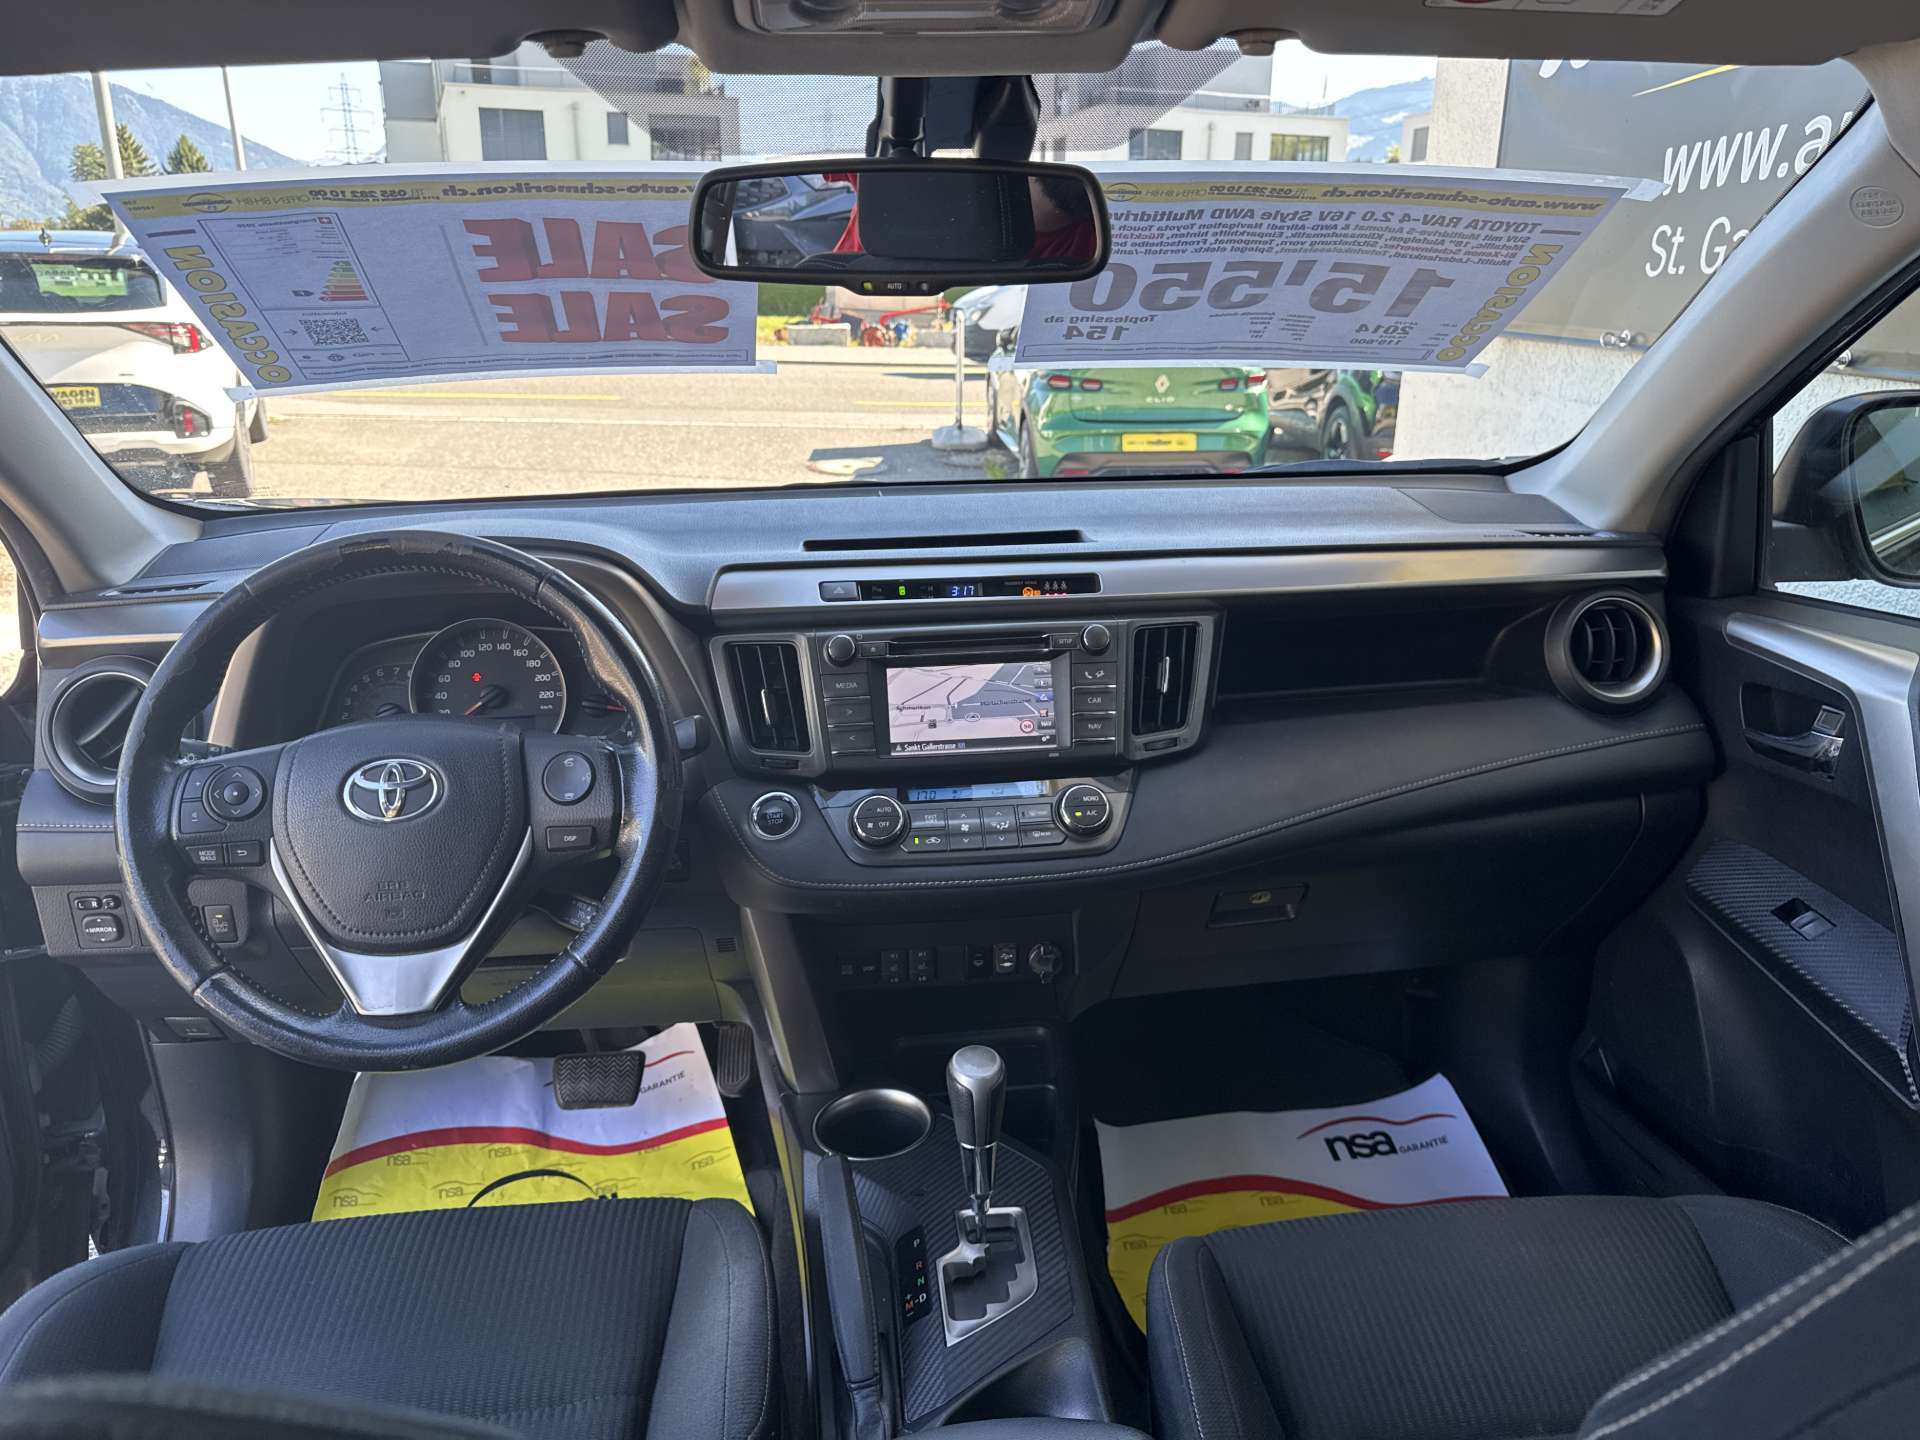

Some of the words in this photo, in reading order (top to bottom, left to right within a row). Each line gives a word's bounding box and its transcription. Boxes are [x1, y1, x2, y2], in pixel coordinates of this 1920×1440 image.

[1661, 111, 1853, 196] www.a
[1645, 225, 1686, 278] St.
[1700, 216, 1749, 275] G
[887, 282, 902, 290] AUTO
[478, 643, 492, 651] 120
[497, 642, 511, 650] 140
[460, 650, 475, 658] 100
[513, 649, 528, 657] 160
[448, 659, 461, 668] 80
[525, 659, 541, 668] 180
[438, 674, 451, 683] 60
[534, 674, 551, 682] 200
[434, 692, 447, 700] 40
[538, 690, 554, 699] 220
[1088, 722, 1103, 730] NAV
[904, 743, 921, 751] Sankt
[1323, 1129, 1399, 1162] nsa
[1399, 1135, 1449, 1154] GARANTIE
[487, 1145, 512, 1159] nsa
[386, 1153, 411, 1167] nsa
[438, 1186, 464, 1200] nsa
[333, 1195, 358, 1208] nsa
[913, 1238, 920, 1248] P
[917, 1275, 925, 1287] N
